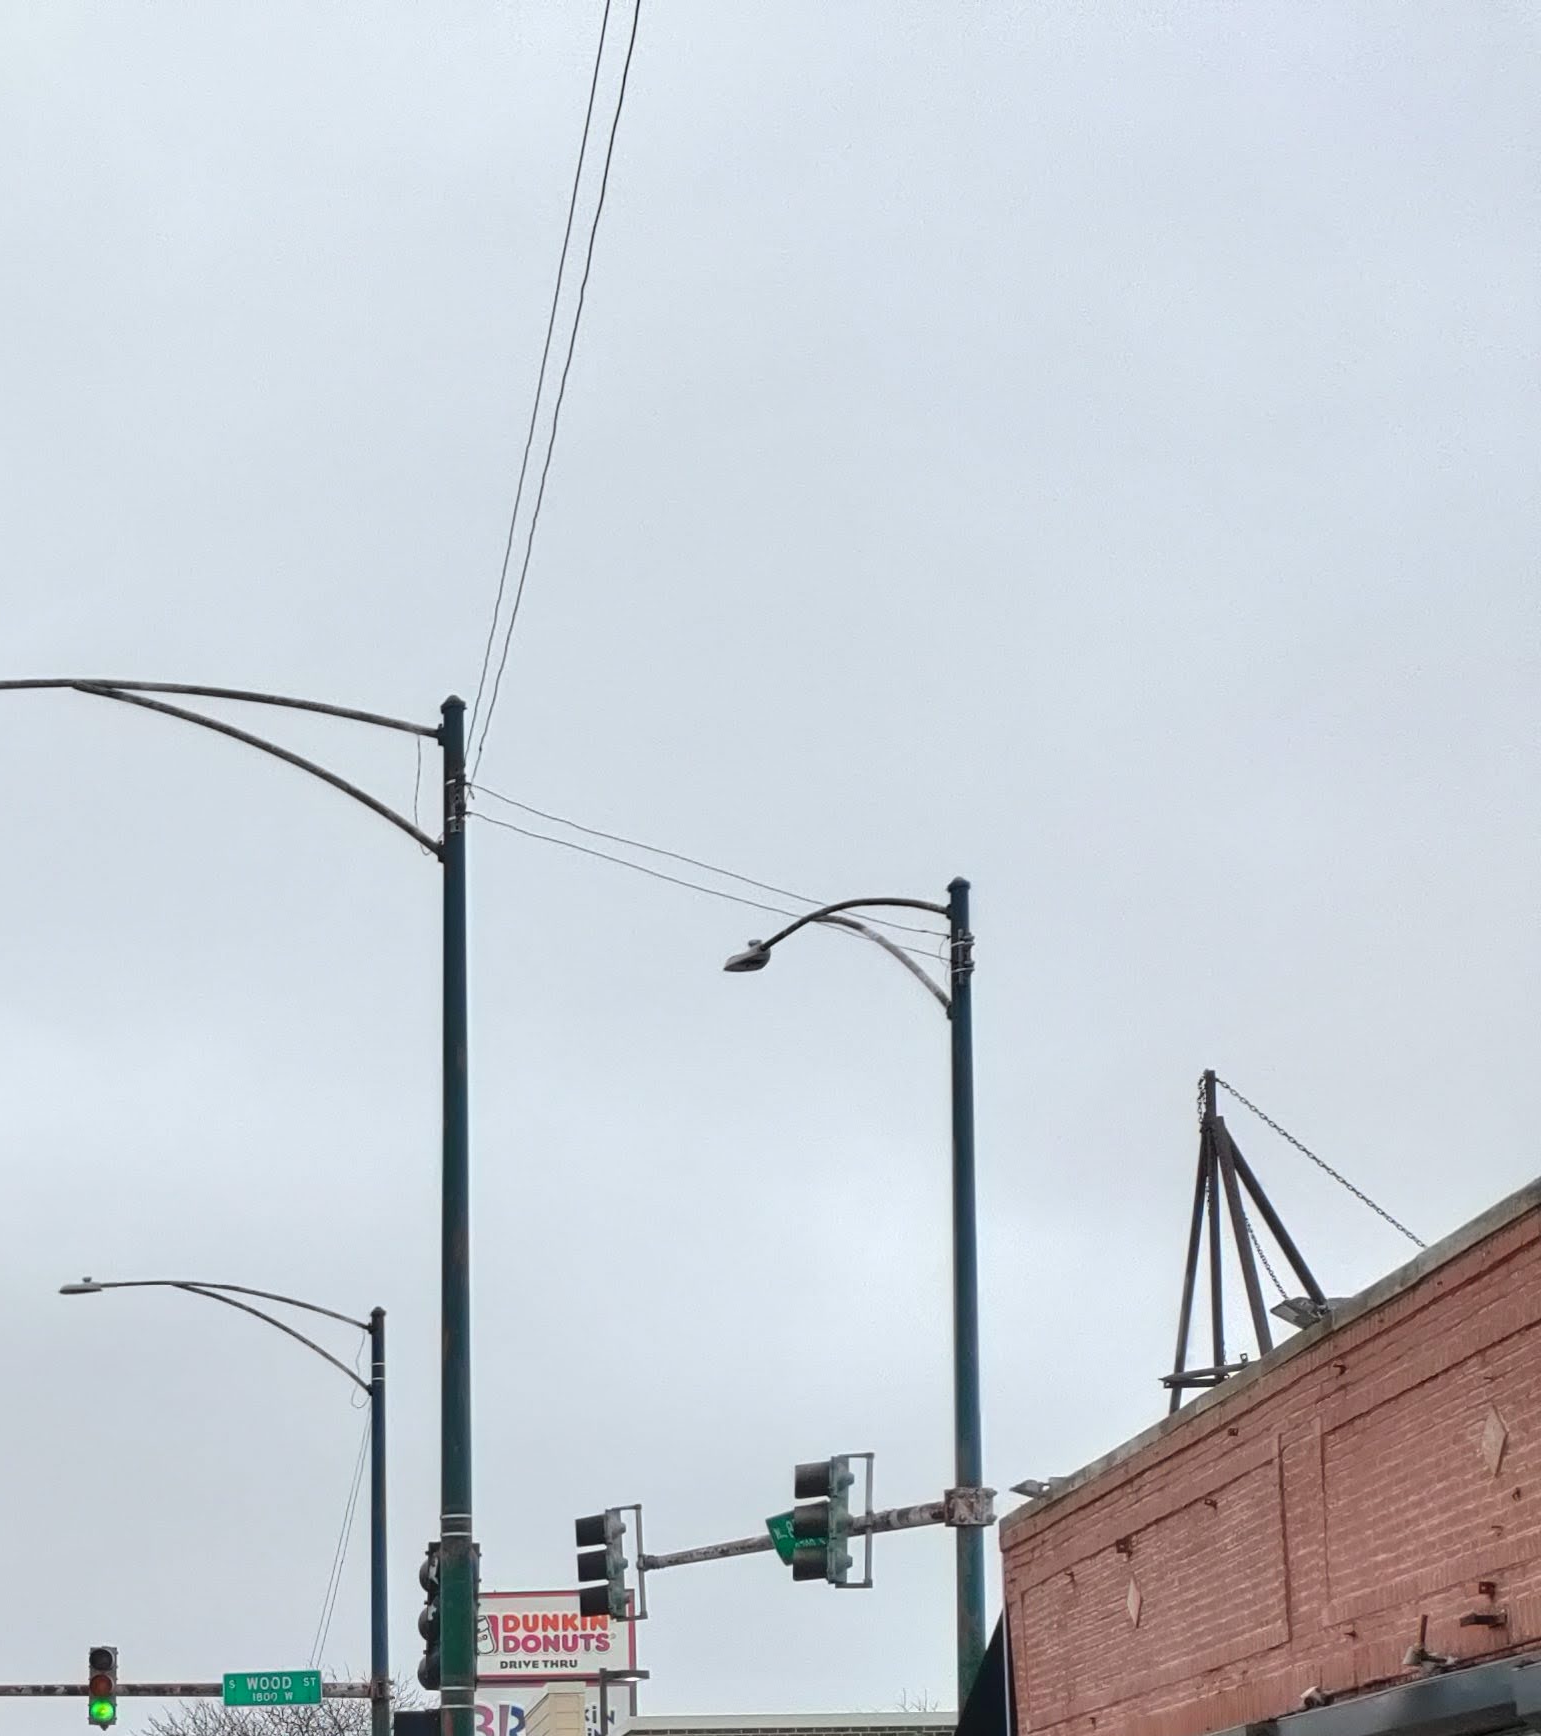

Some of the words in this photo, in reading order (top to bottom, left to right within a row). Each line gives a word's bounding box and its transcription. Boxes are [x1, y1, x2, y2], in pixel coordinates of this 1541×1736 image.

[503, 1633, 611, 1653] DONUTS
[500, 1660, 539, 1669] DRIVE
[542, 1659, 578, 1668] THRU
[229, 1680, 235, 1689] S
[246, 1676, 292, 1690] WOOD
[303, 1677, 316, 1687] ST
[252, 1692, 277, 1702] 1800
[284, 1691, 293, 1701] W
